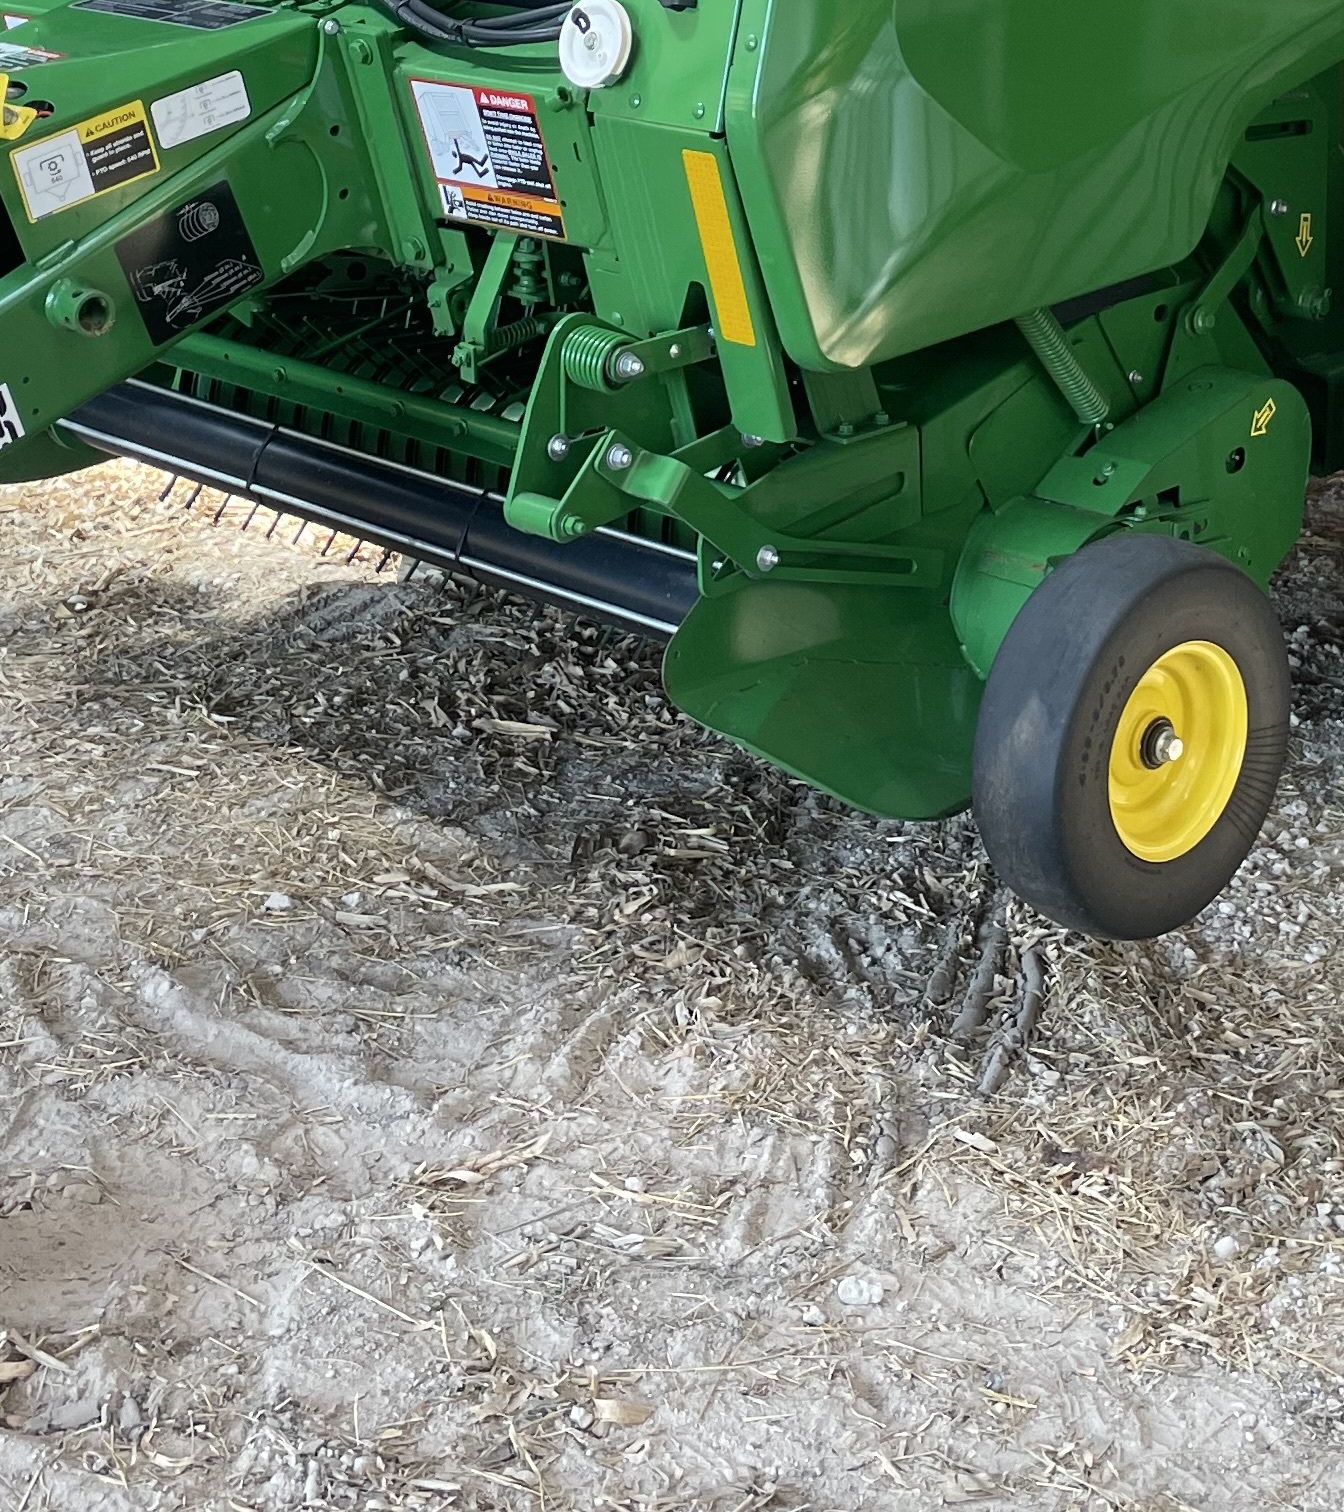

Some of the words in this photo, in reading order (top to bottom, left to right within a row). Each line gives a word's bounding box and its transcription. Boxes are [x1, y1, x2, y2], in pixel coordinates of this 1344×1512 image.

[489, 94, 529, 109] DANGER
[94, 110, 136, 132] CAUTION
[493, 194, 533, 210] WARNING
